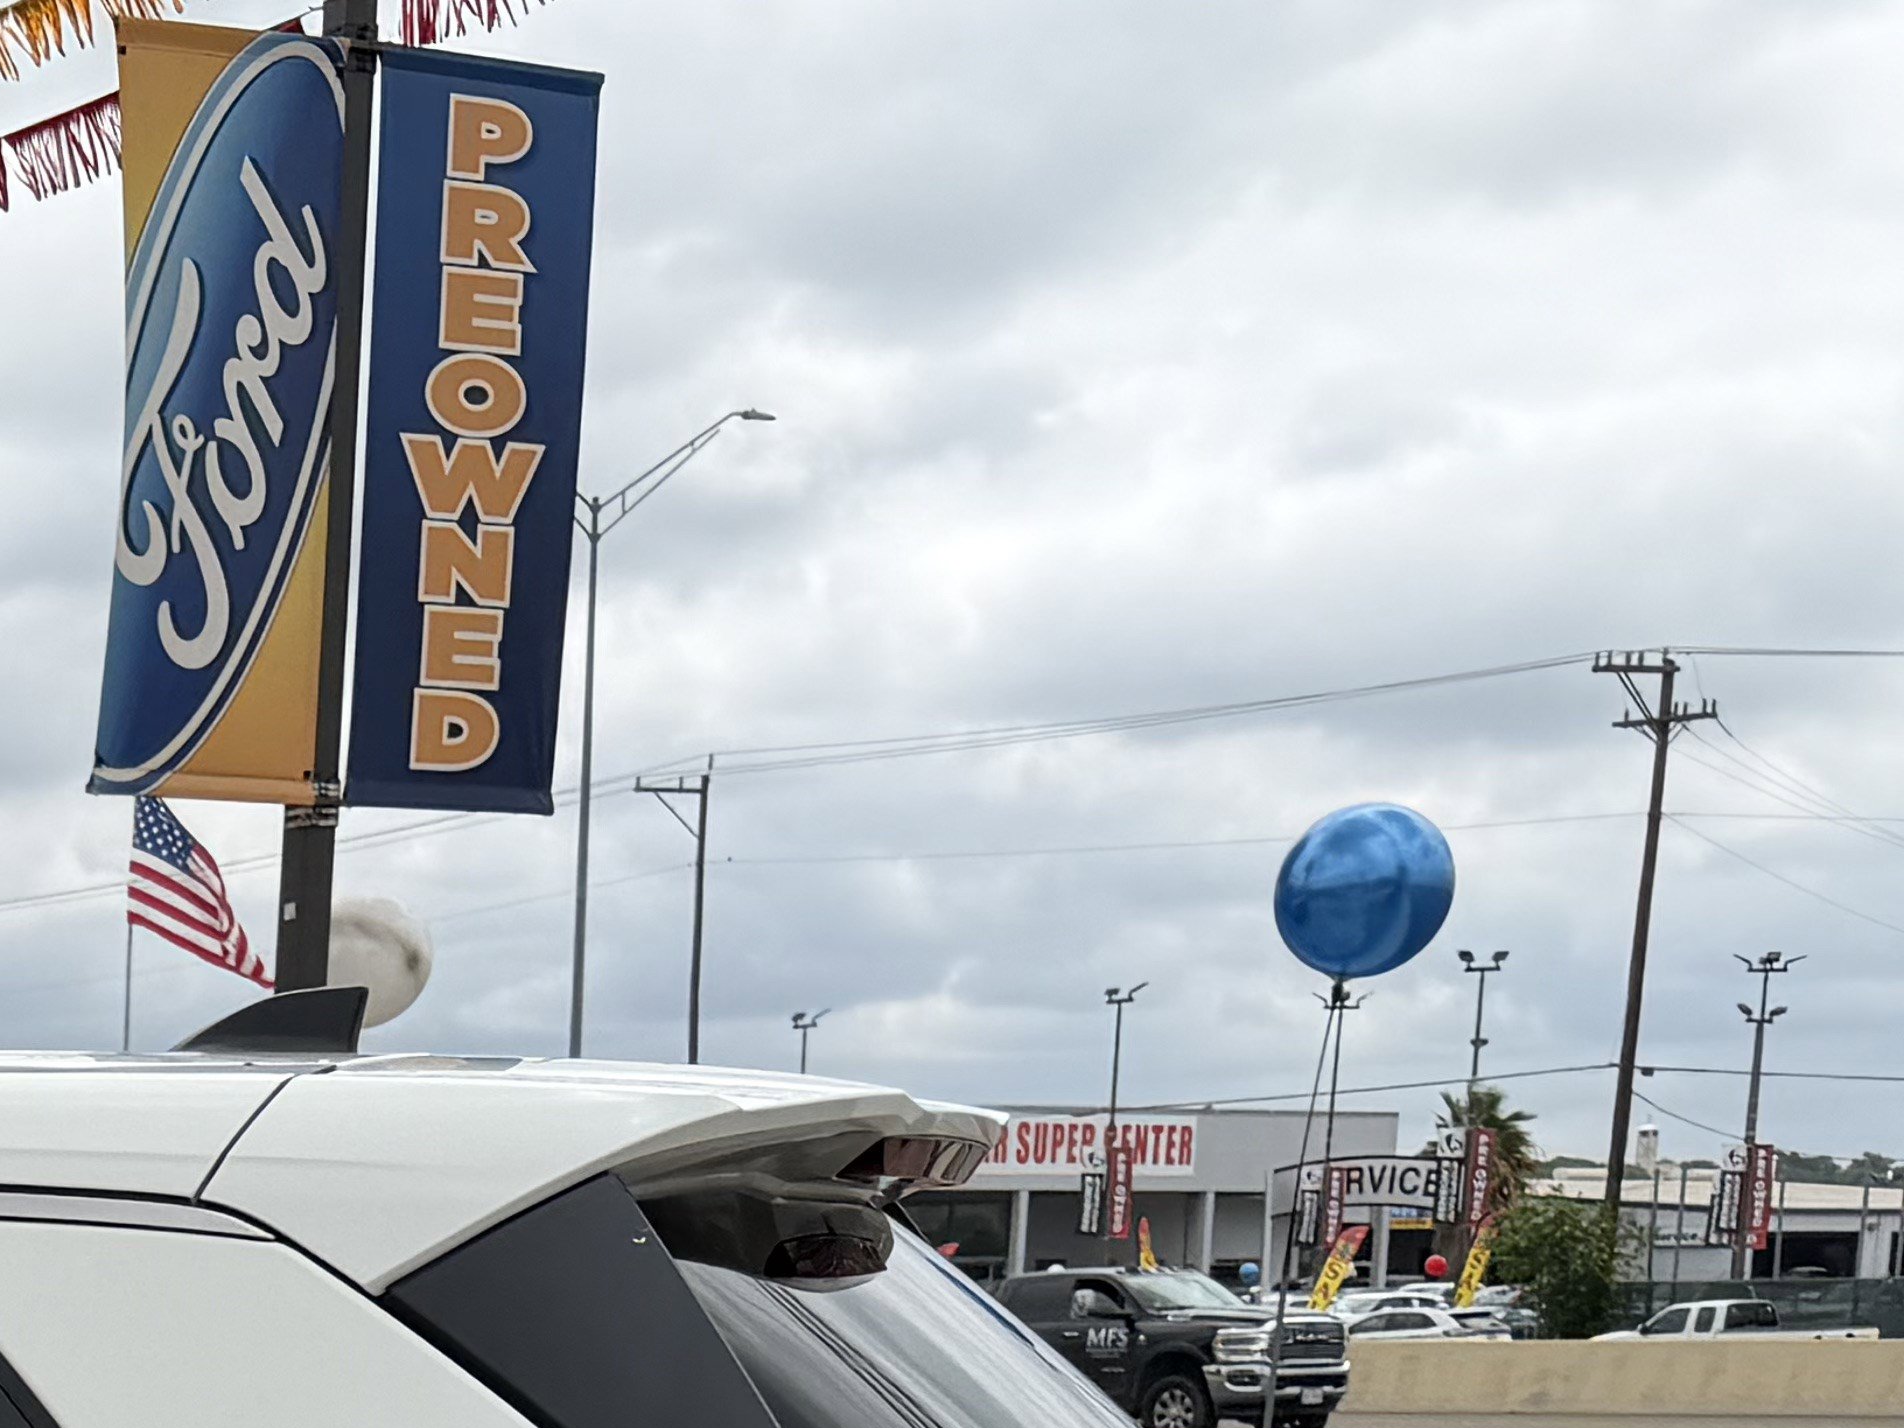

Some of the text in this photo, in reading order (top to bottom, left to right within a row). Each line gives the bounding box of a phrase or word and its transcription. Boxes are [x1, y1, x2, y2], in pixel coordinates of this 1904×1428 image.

[115, 156, 327, 669] Ford
[399, 93, 545, 772] PREOWNED
[1346, 1164, 1436, 1197] RVICE
